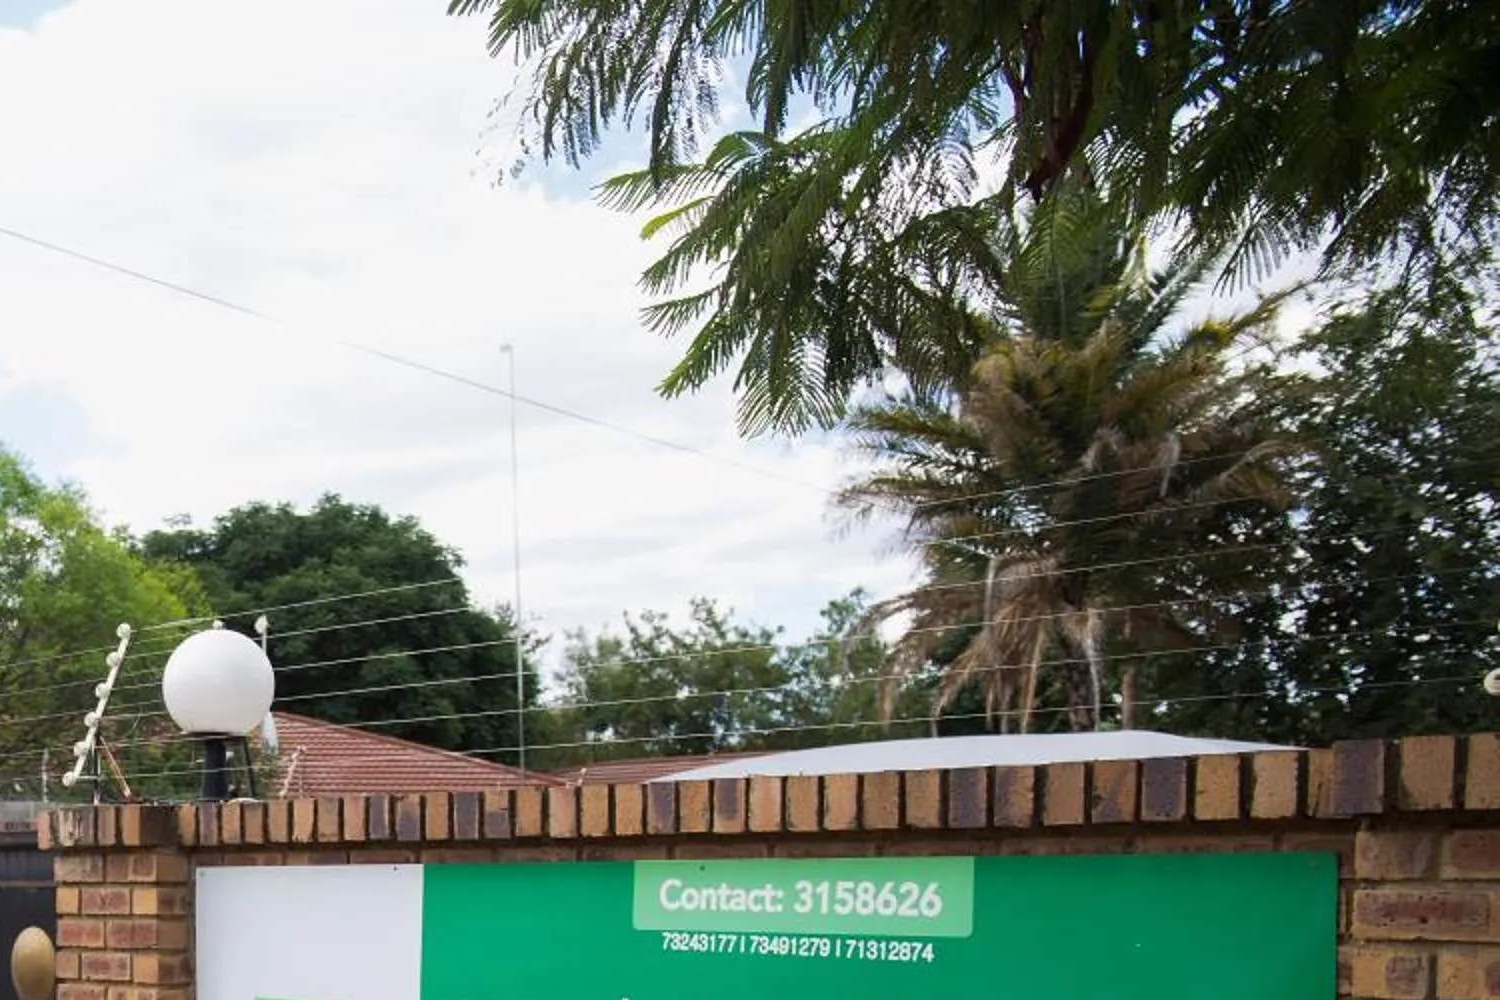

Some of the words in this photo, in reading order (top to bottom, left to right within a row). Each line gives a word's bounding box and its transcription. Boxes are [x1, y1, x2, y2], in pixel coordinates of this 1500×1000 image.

[659, 878, 784, 913] Contact:
[794, 880, 943, 917] 3158626
[662, 932, 737, 953] 73243177
[750, 936, 830, 958] 73491279
[846, 940, 934, 963] 71312874
